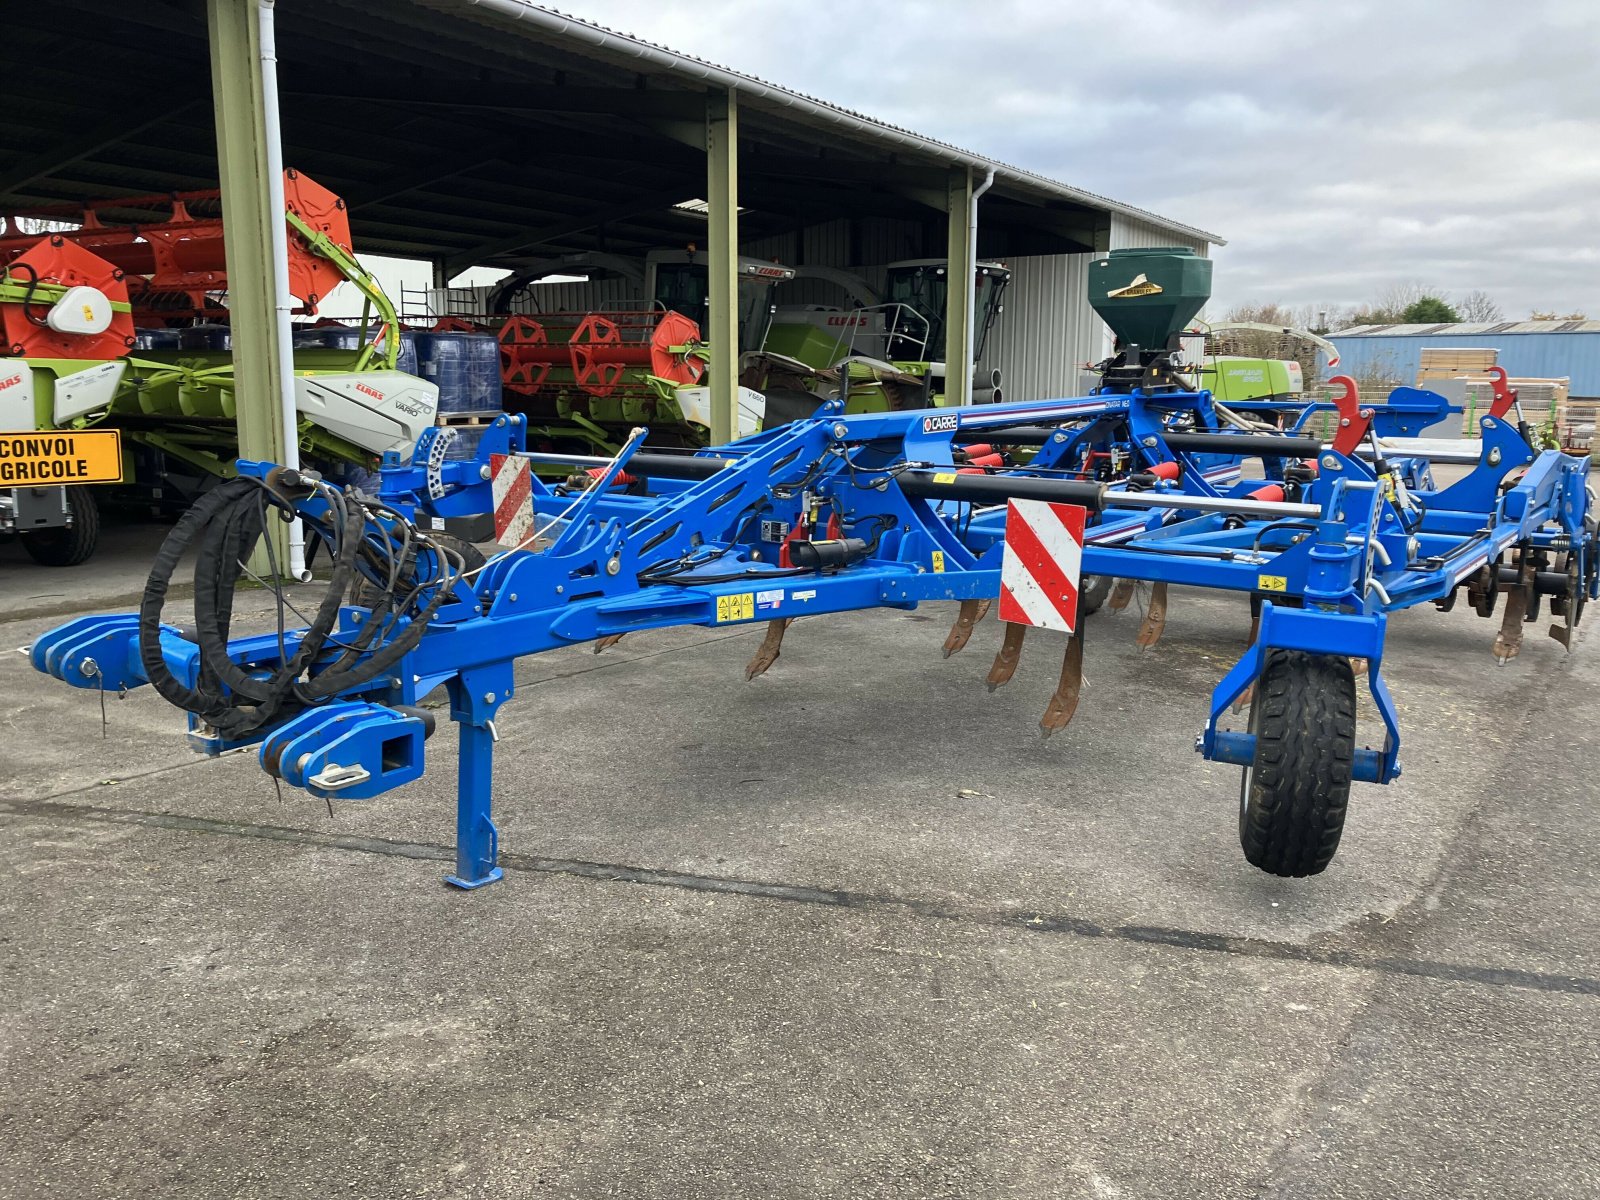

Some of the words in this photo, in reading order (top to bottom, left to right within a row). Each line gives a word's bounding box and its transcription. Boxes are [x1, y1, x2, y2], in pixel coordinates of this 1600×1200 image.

[758, 267, 785, 277] CLAAS
[827, 316, 868, 327] CLAAS
[0, 374, 21, 392] AAS
[355, 383, 385, 401] CLAAS
[395, 400, 419, 417] VARIO
[0, 438, 75, 458] CONVOI
[0, 460, 88, 480] GRICOLE
